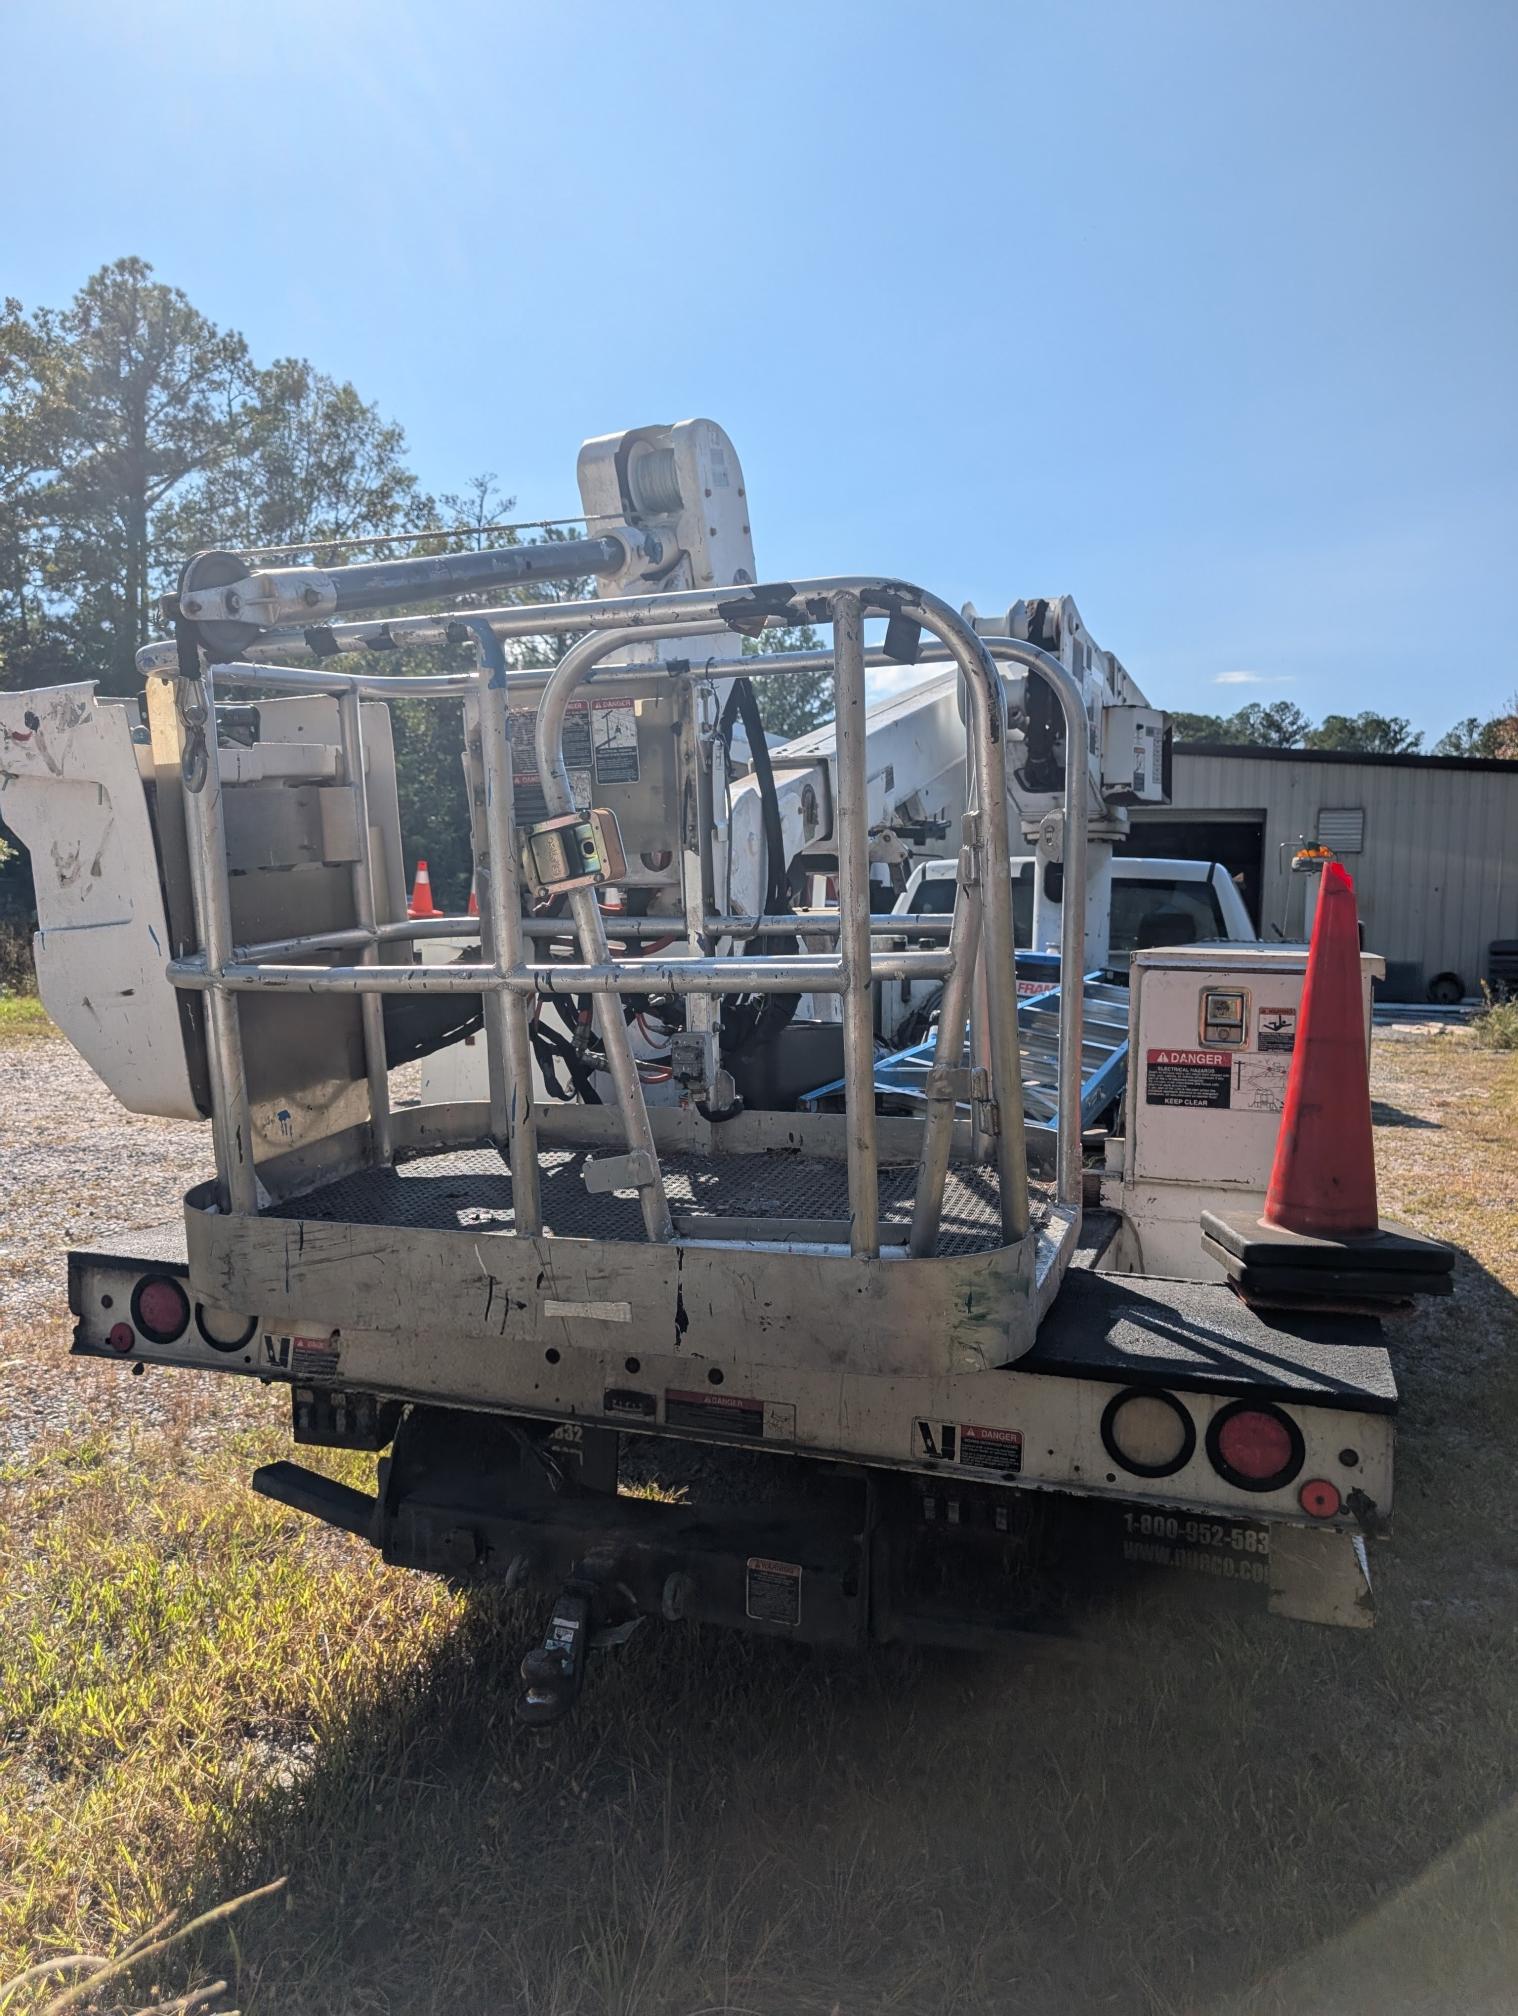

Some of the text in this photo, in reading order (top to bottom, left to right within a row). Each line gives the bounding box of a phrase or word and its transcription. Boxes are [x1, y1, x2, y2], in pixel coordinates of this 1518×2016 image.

[1170, 1052, 1223, 1065] DANGER
[981, 1429, 1018, 1442] DANGER
[1123, 1512, 1270, 1555] 1-800-952-583
